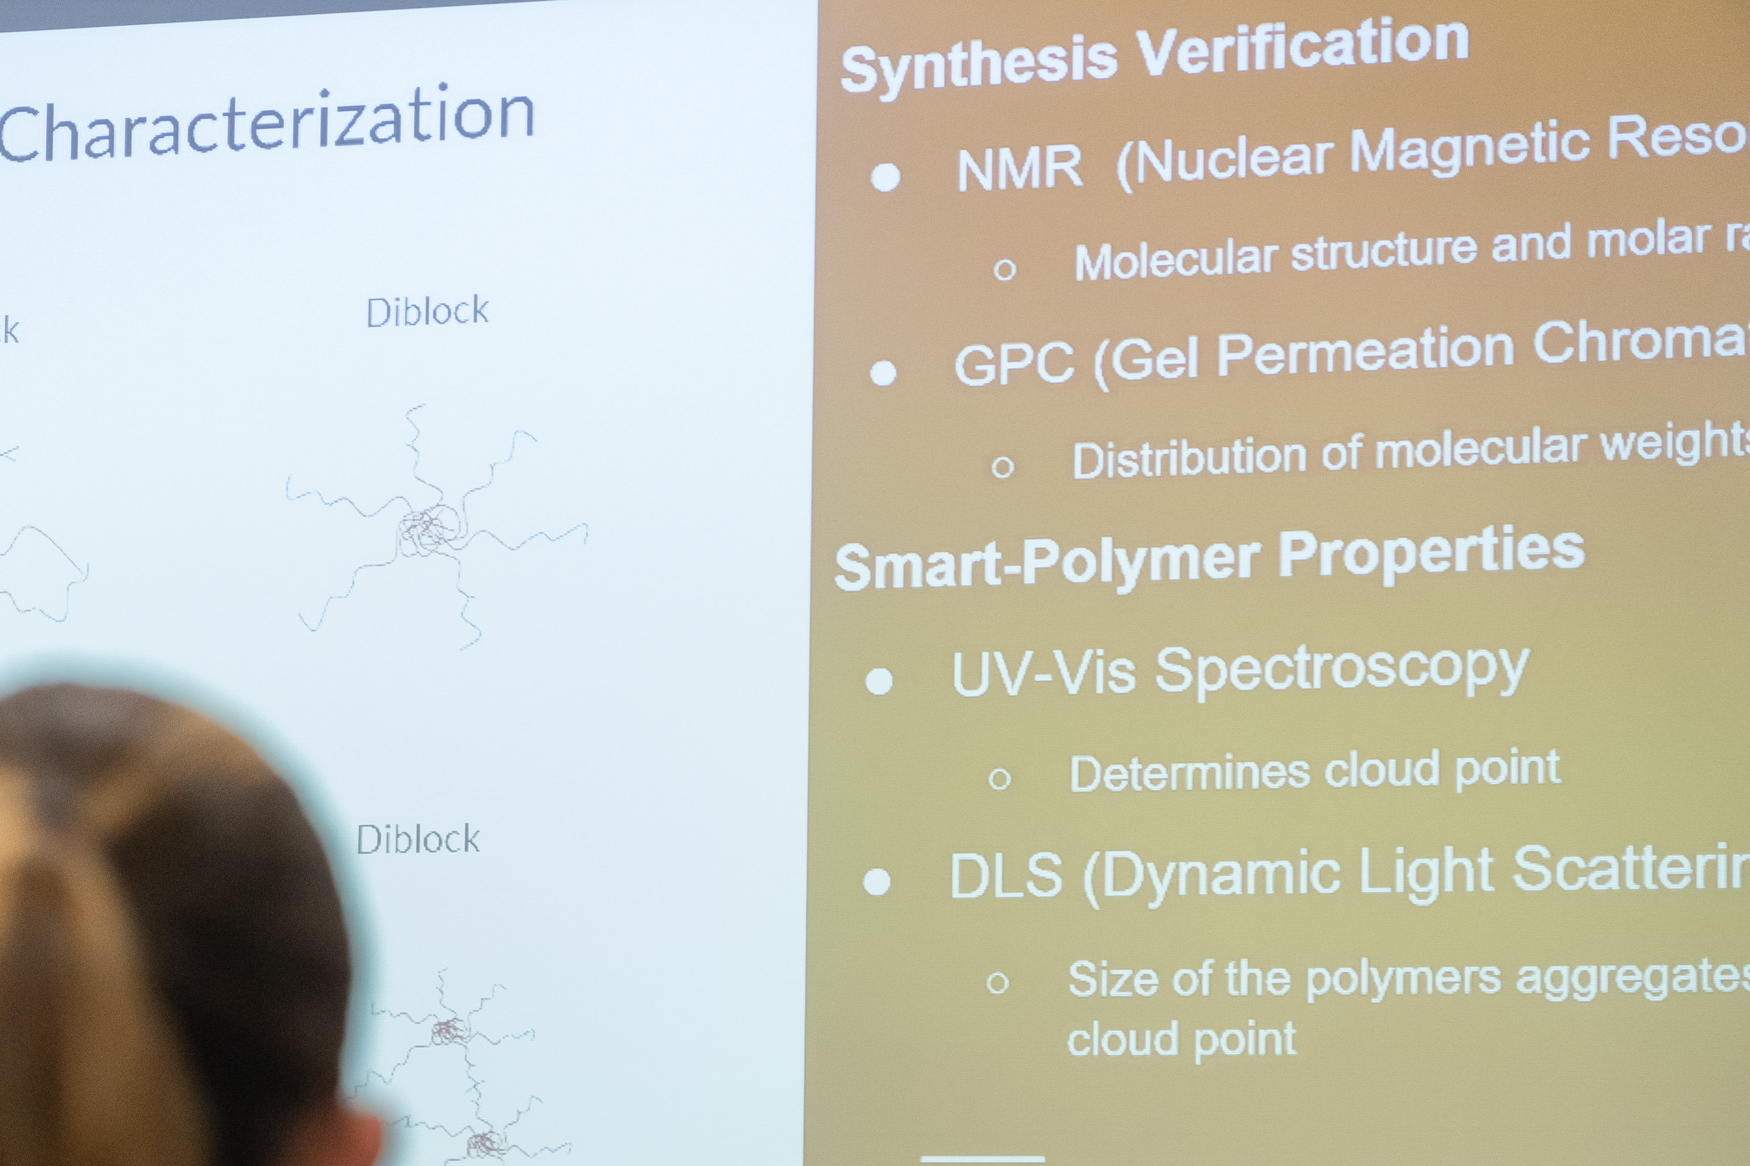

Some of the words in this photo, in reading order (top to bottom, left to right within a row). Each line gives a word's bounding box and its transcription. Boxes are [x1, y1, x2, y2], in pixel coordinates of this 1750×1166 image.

[840, 33, 1118, 103] Synthesis
[1135, 15, 1469, 76] Verification
[959, 143, 1084, 192] NMR
[1117, 134, 1335, 194] (Nuclear
[1351, 118, 1591, 179] Magnetic
[1075, 237, 1280, 282] Molecular
[1291, 231, 1478, 272] structure
[1491, 221, 1571, 263] and
[1588, 216, 1713, 258] molar
[367, 293, 489, 328] Diblock
[955, 341, 1075, 387] GPC
[1094, 335, 1198, 393] (Gel
[1218, 324, 1514, 377] Permeation
[1533, 318, 1750, 364] Chroma
[1073, 436, 1307, 480] Distribution
[1322, 432, 1365, 471] of
[1376, 425, 1589, 469] molecular
[1599, 419, 1750, 467] weight
[834, 536, 1263, 596] Smart-Polymer
[1279, 524, 1585, 588] Properties
[953, 648, 1136, 697] UV-Vis
[1155, 643, 1531, 704] Spectroscopy
[1071, 752, 1311, 793] Determines
[1324, 748, 1440, 788] cloud
[1456, 746, 1562, 794] point
[357, 822, 481, 855] Diblock
[951, 851, 1063, 899] DLS
[1084, 847, 1341, 911] (Dynamic
[1361, 845, 1496, 907] Light
[1069, 959, 1160, 997] Size
[1172, 958, 1215, 997] of
[1224, 958, 1291, 996] the
[1307, 956, 1502, 1004] polymers
[1067, 1019, 1179, 1056] cloud
[1195, 1018, 1298, 1066] point
